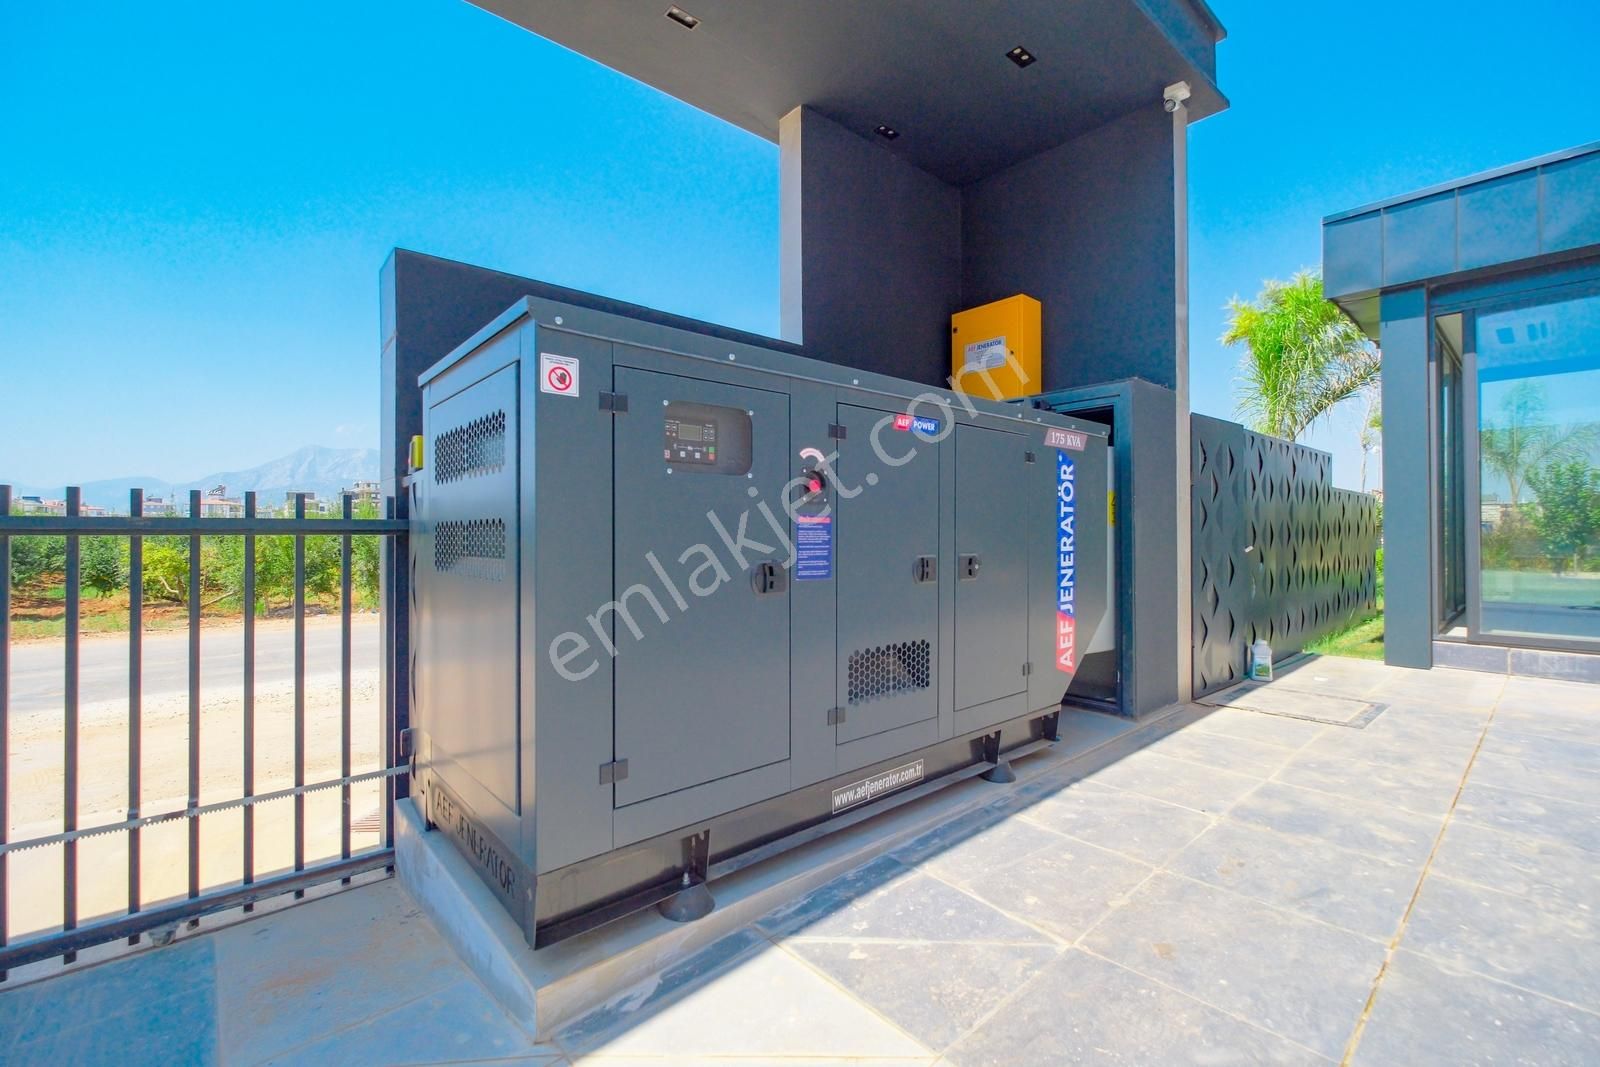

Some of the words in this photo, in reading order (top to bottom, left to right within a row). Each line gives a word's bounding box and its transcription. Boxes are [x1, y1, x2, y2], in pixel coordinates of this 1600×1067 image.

[913, 420, 936, 431] POWER
[1051, 431, 1065, 445] 175
[1066, 433, 1081, 447] KVA
[1058, 462, 1074, 614] JENERATÖR
[1059, 619, 1074, 667] AEF
[834, 764, 922, 807] www.aefjenerator.com.tr
[436, 791, 453, 824] AEF
